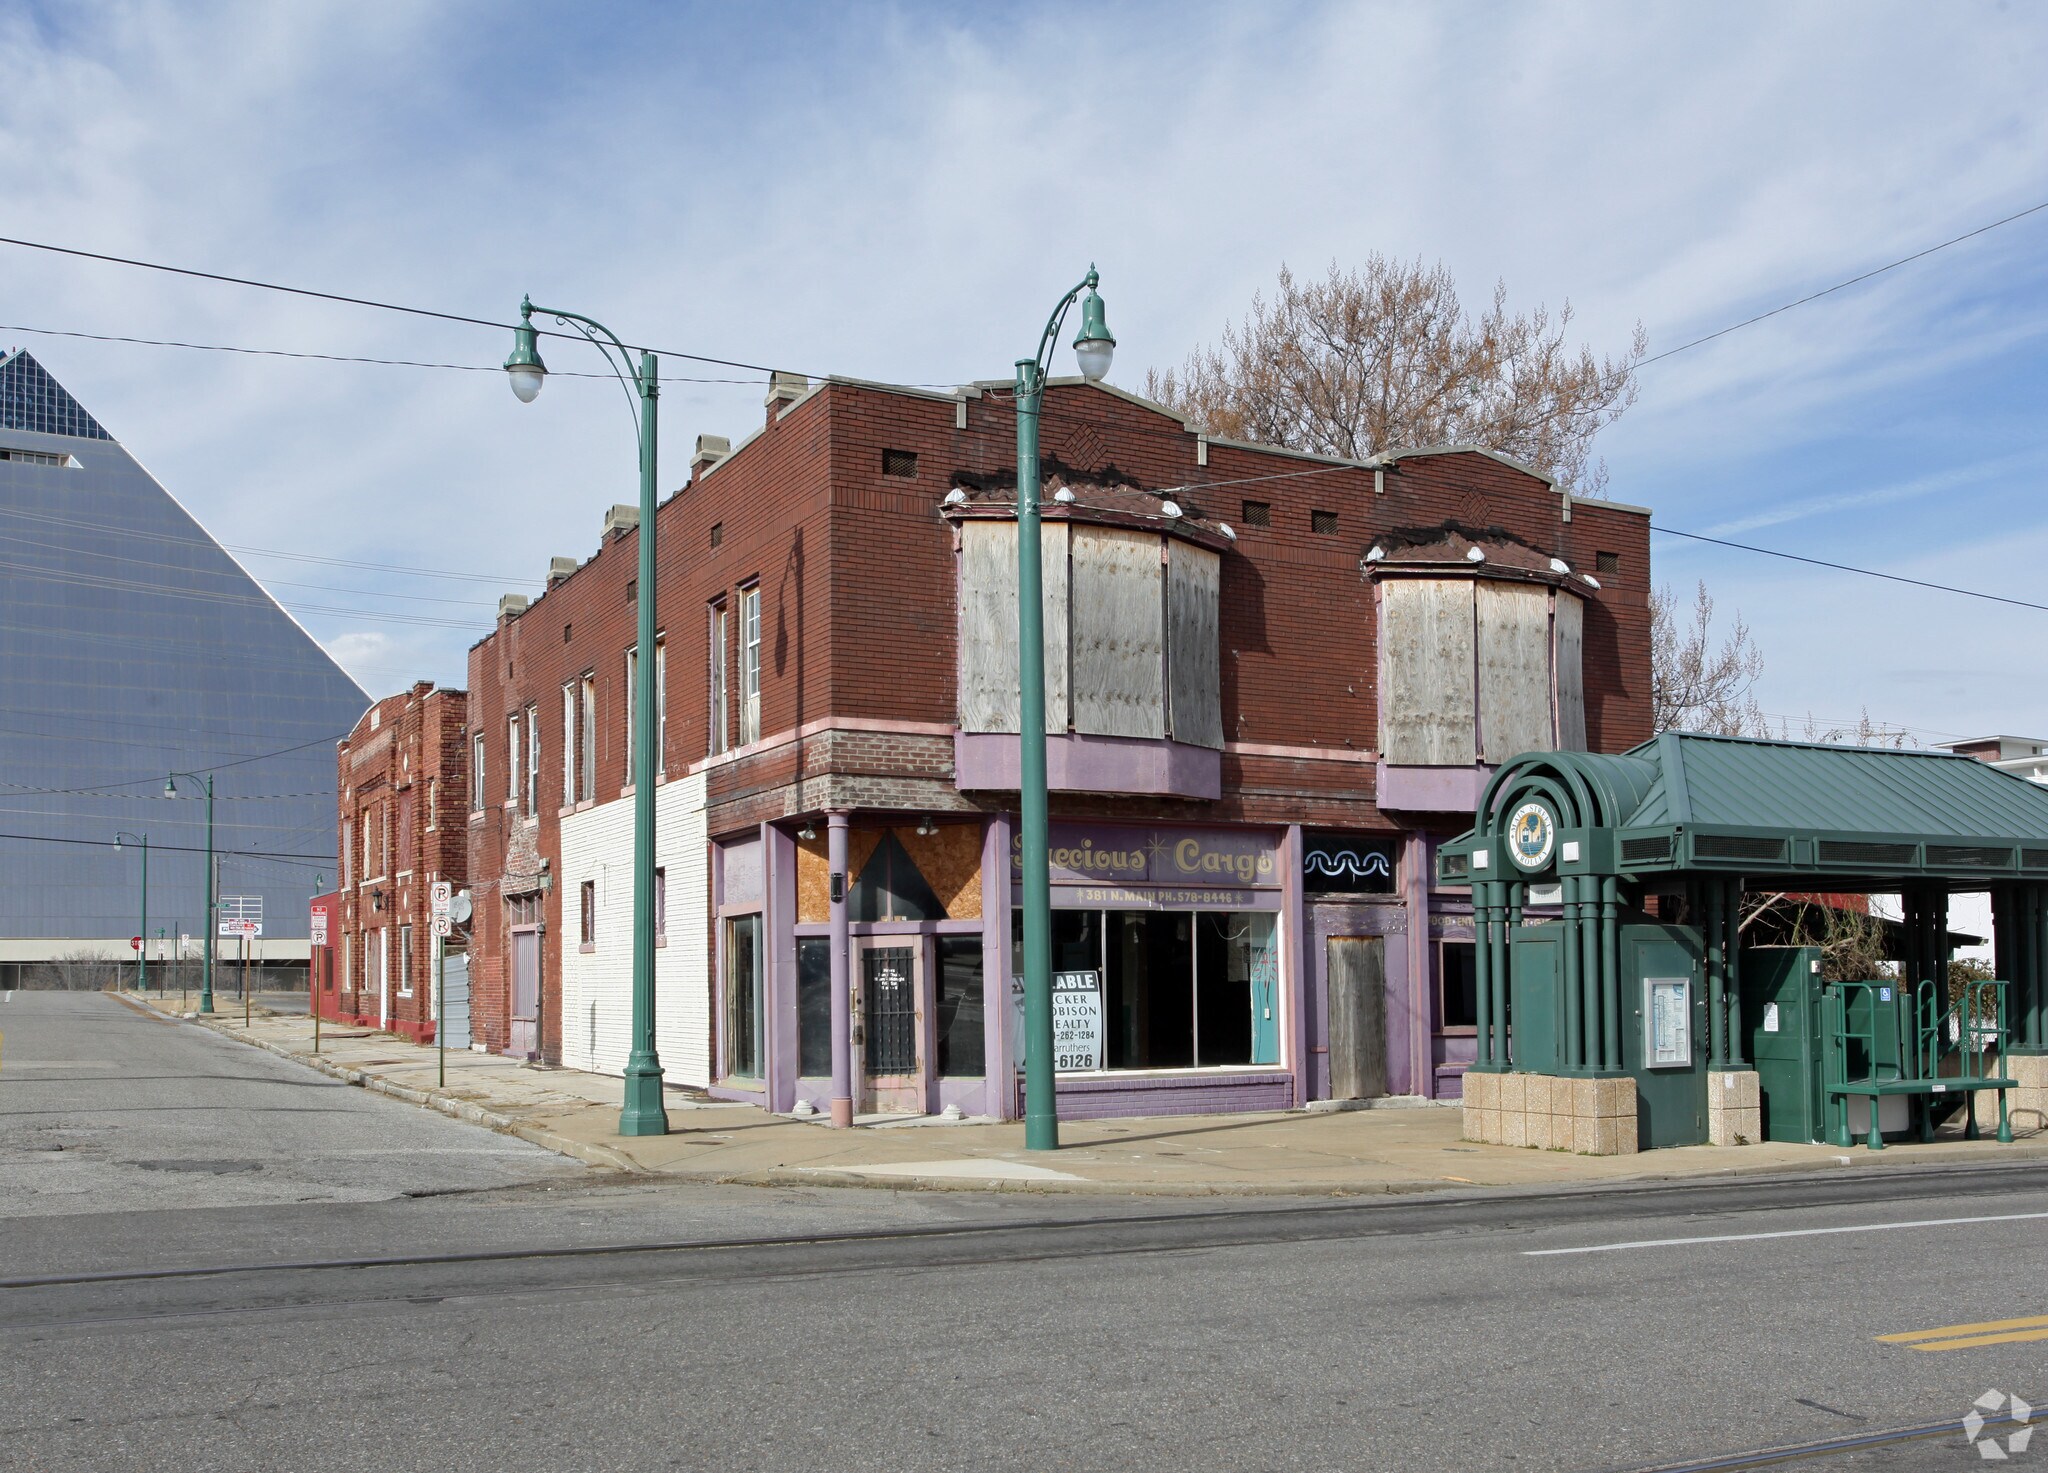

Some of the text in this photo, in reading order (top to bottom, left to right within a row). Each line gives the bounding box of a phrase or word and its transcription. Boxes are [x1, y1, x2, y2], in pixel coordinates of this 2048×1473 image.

[1511, 805, 1552, 832] MAIN STREET
[1011, 833, 1273, 882] ecious Cargo
[1515, 851, 1549, 867] TROLLEY
[1086, 889, 1106, 901] 381
[1428, 916, 1451, 926] OOD
[1055, 994, 1087, 1005] CKER
[1053, 1006, 1097, 1016] BISON
[1055, 1019, 1091, 1029] EALTY
[1053, 1030, 1095, 1040] -262-1284
[1054, 1043, 1091, 1053] arruthers
